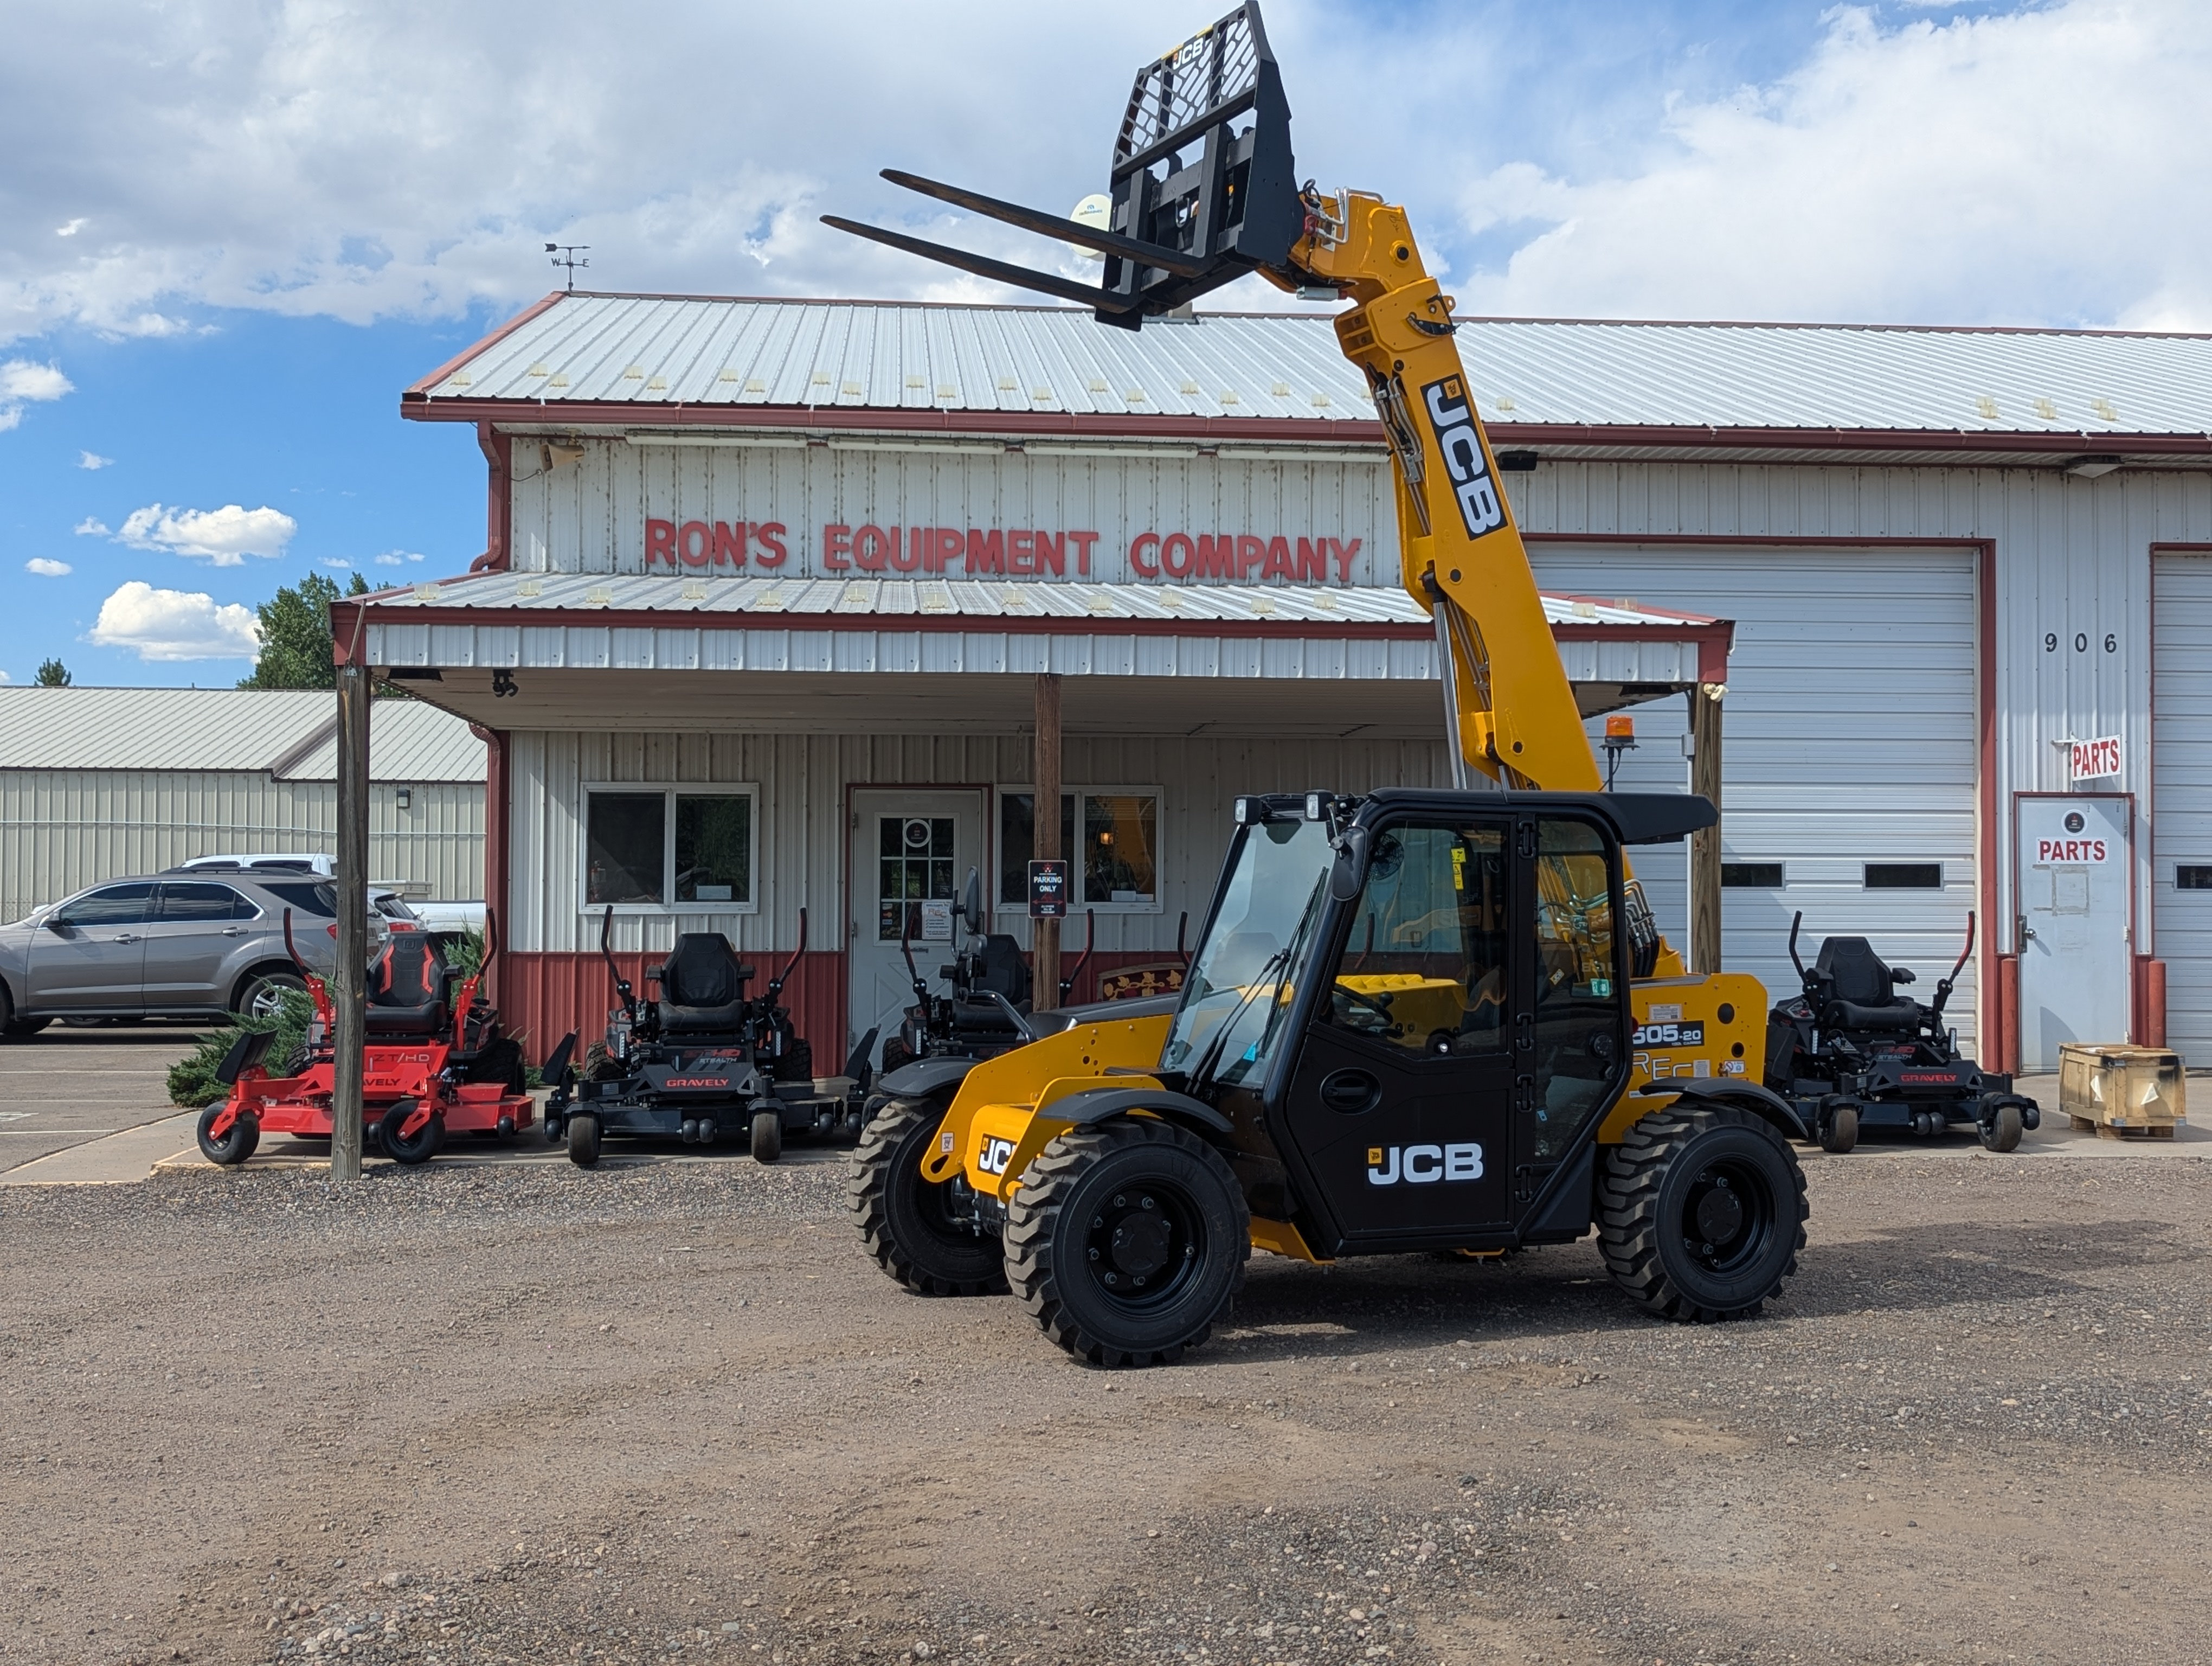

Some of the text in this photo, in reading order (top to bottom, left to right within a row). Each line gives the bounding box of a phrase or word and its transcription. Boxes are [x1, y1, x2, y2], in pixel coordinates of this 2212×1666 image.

[1173, 37, 1203, 70] JCB
[582, 259, 589, 267] E
[1426, 383, 1501, 534] JCB
[646, 519, 1362, 582] RON'S EQUIPMENT COMPANY
[2073, 739, 2120, 778] PARTS
[2039, 841, 2106, 861] PARTS
[1632, 1024, 1701, 1045] 505-20
[666, 1078, 729, 1087] GRAVELY
[979, 1139, 1017, 1174] JC
[1368, 1143, 1483, 1184] JCB
